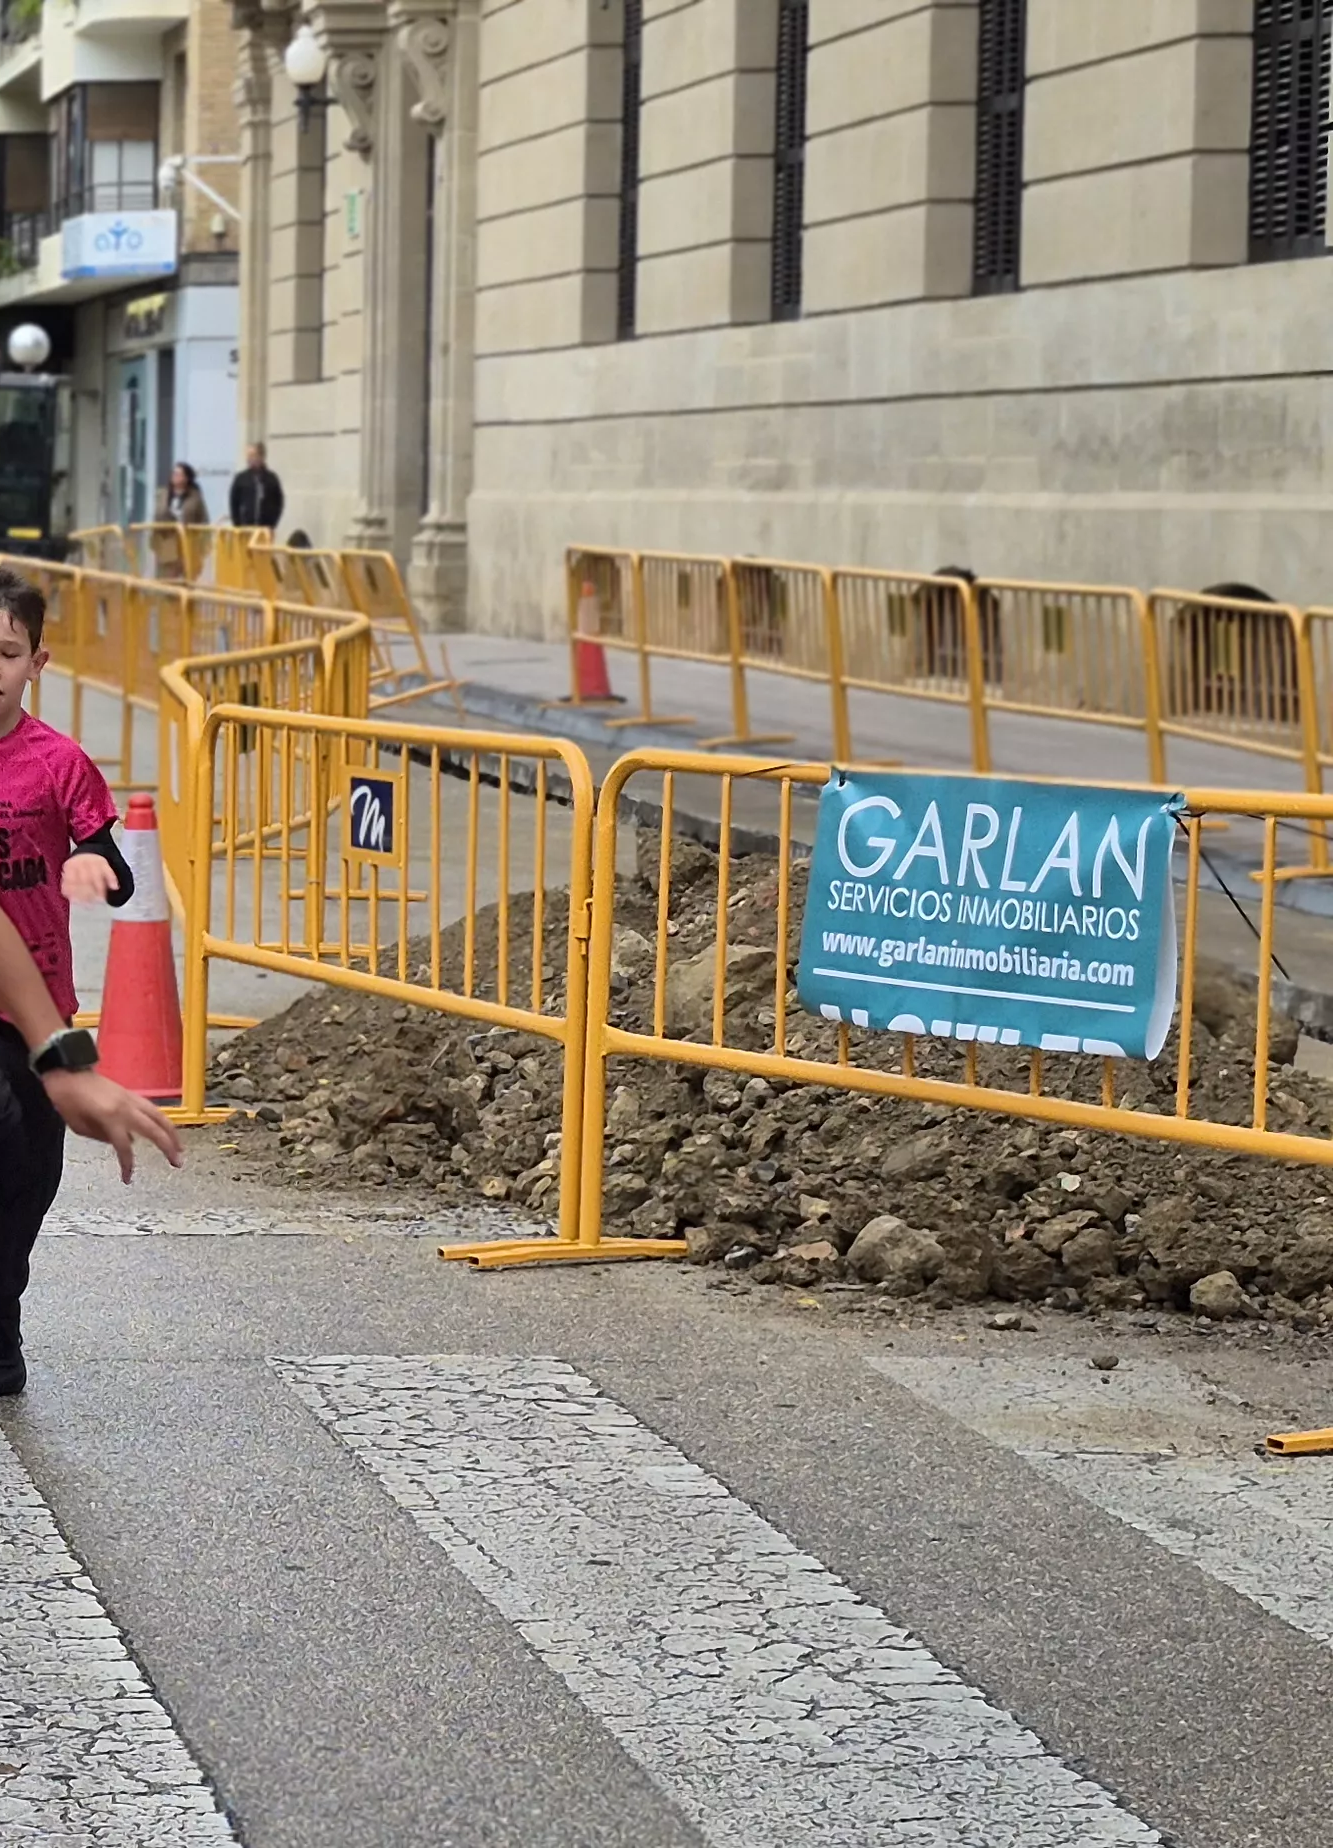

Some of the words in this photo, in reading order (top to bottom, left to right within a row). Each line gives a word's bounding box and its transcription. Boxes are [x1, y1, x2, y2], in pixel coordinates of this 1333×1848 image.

[837, 796, 1152, 901] GARLAN
[828, 880, 952, 924] SERVICIOS
[957, 894, 1140, 941] INMOBILIARIOS
[822, 930, 1134, 987] www.garlaninmobiliaria.com
